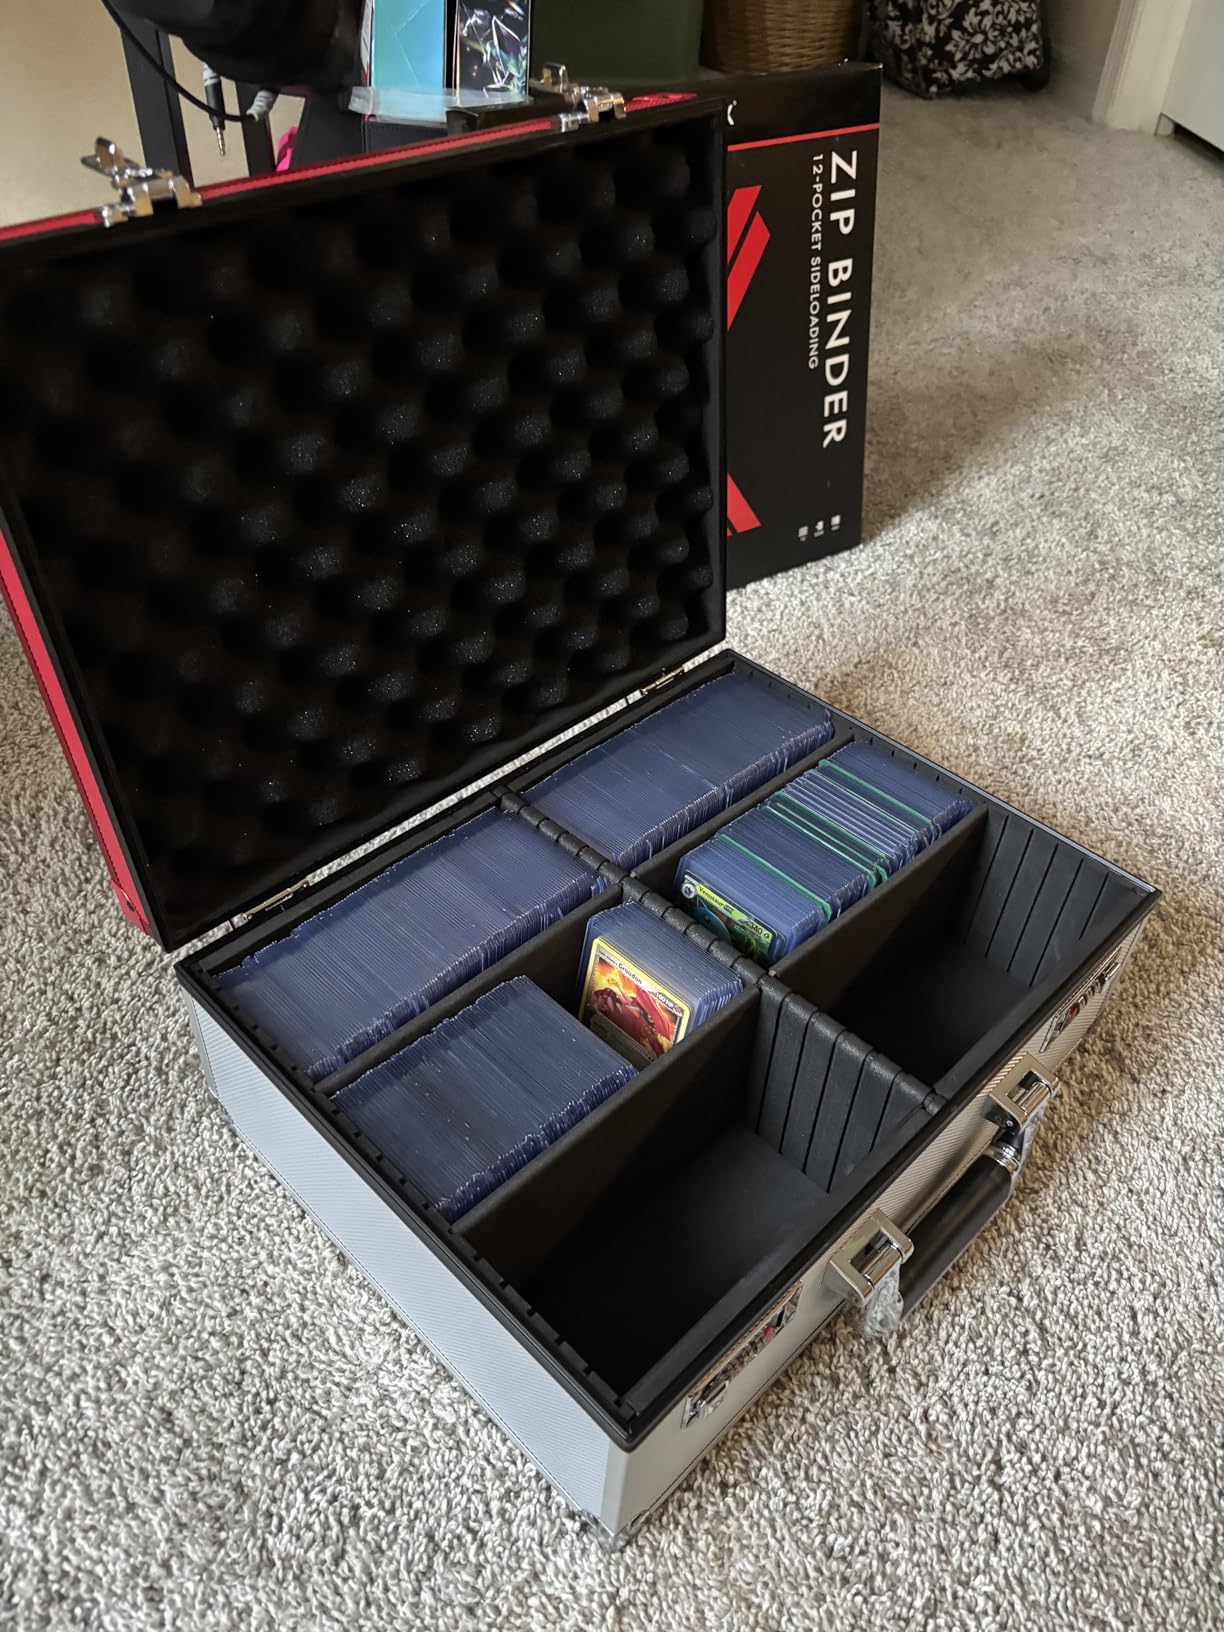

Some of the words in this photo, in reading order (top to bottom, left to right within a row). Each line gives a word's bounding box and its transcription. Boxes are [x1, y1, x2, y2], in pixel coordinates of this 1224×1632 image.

[811, 153, 824, 250] 12-POCKET
[829, 150, 858, 235] ZIP
[808, 256, 822, 370] SIDELOADING
[822, 258, 853, 449] BINDER
[749, 921, 763, 934] 340
[618, 963, 643, 985] Groudon
